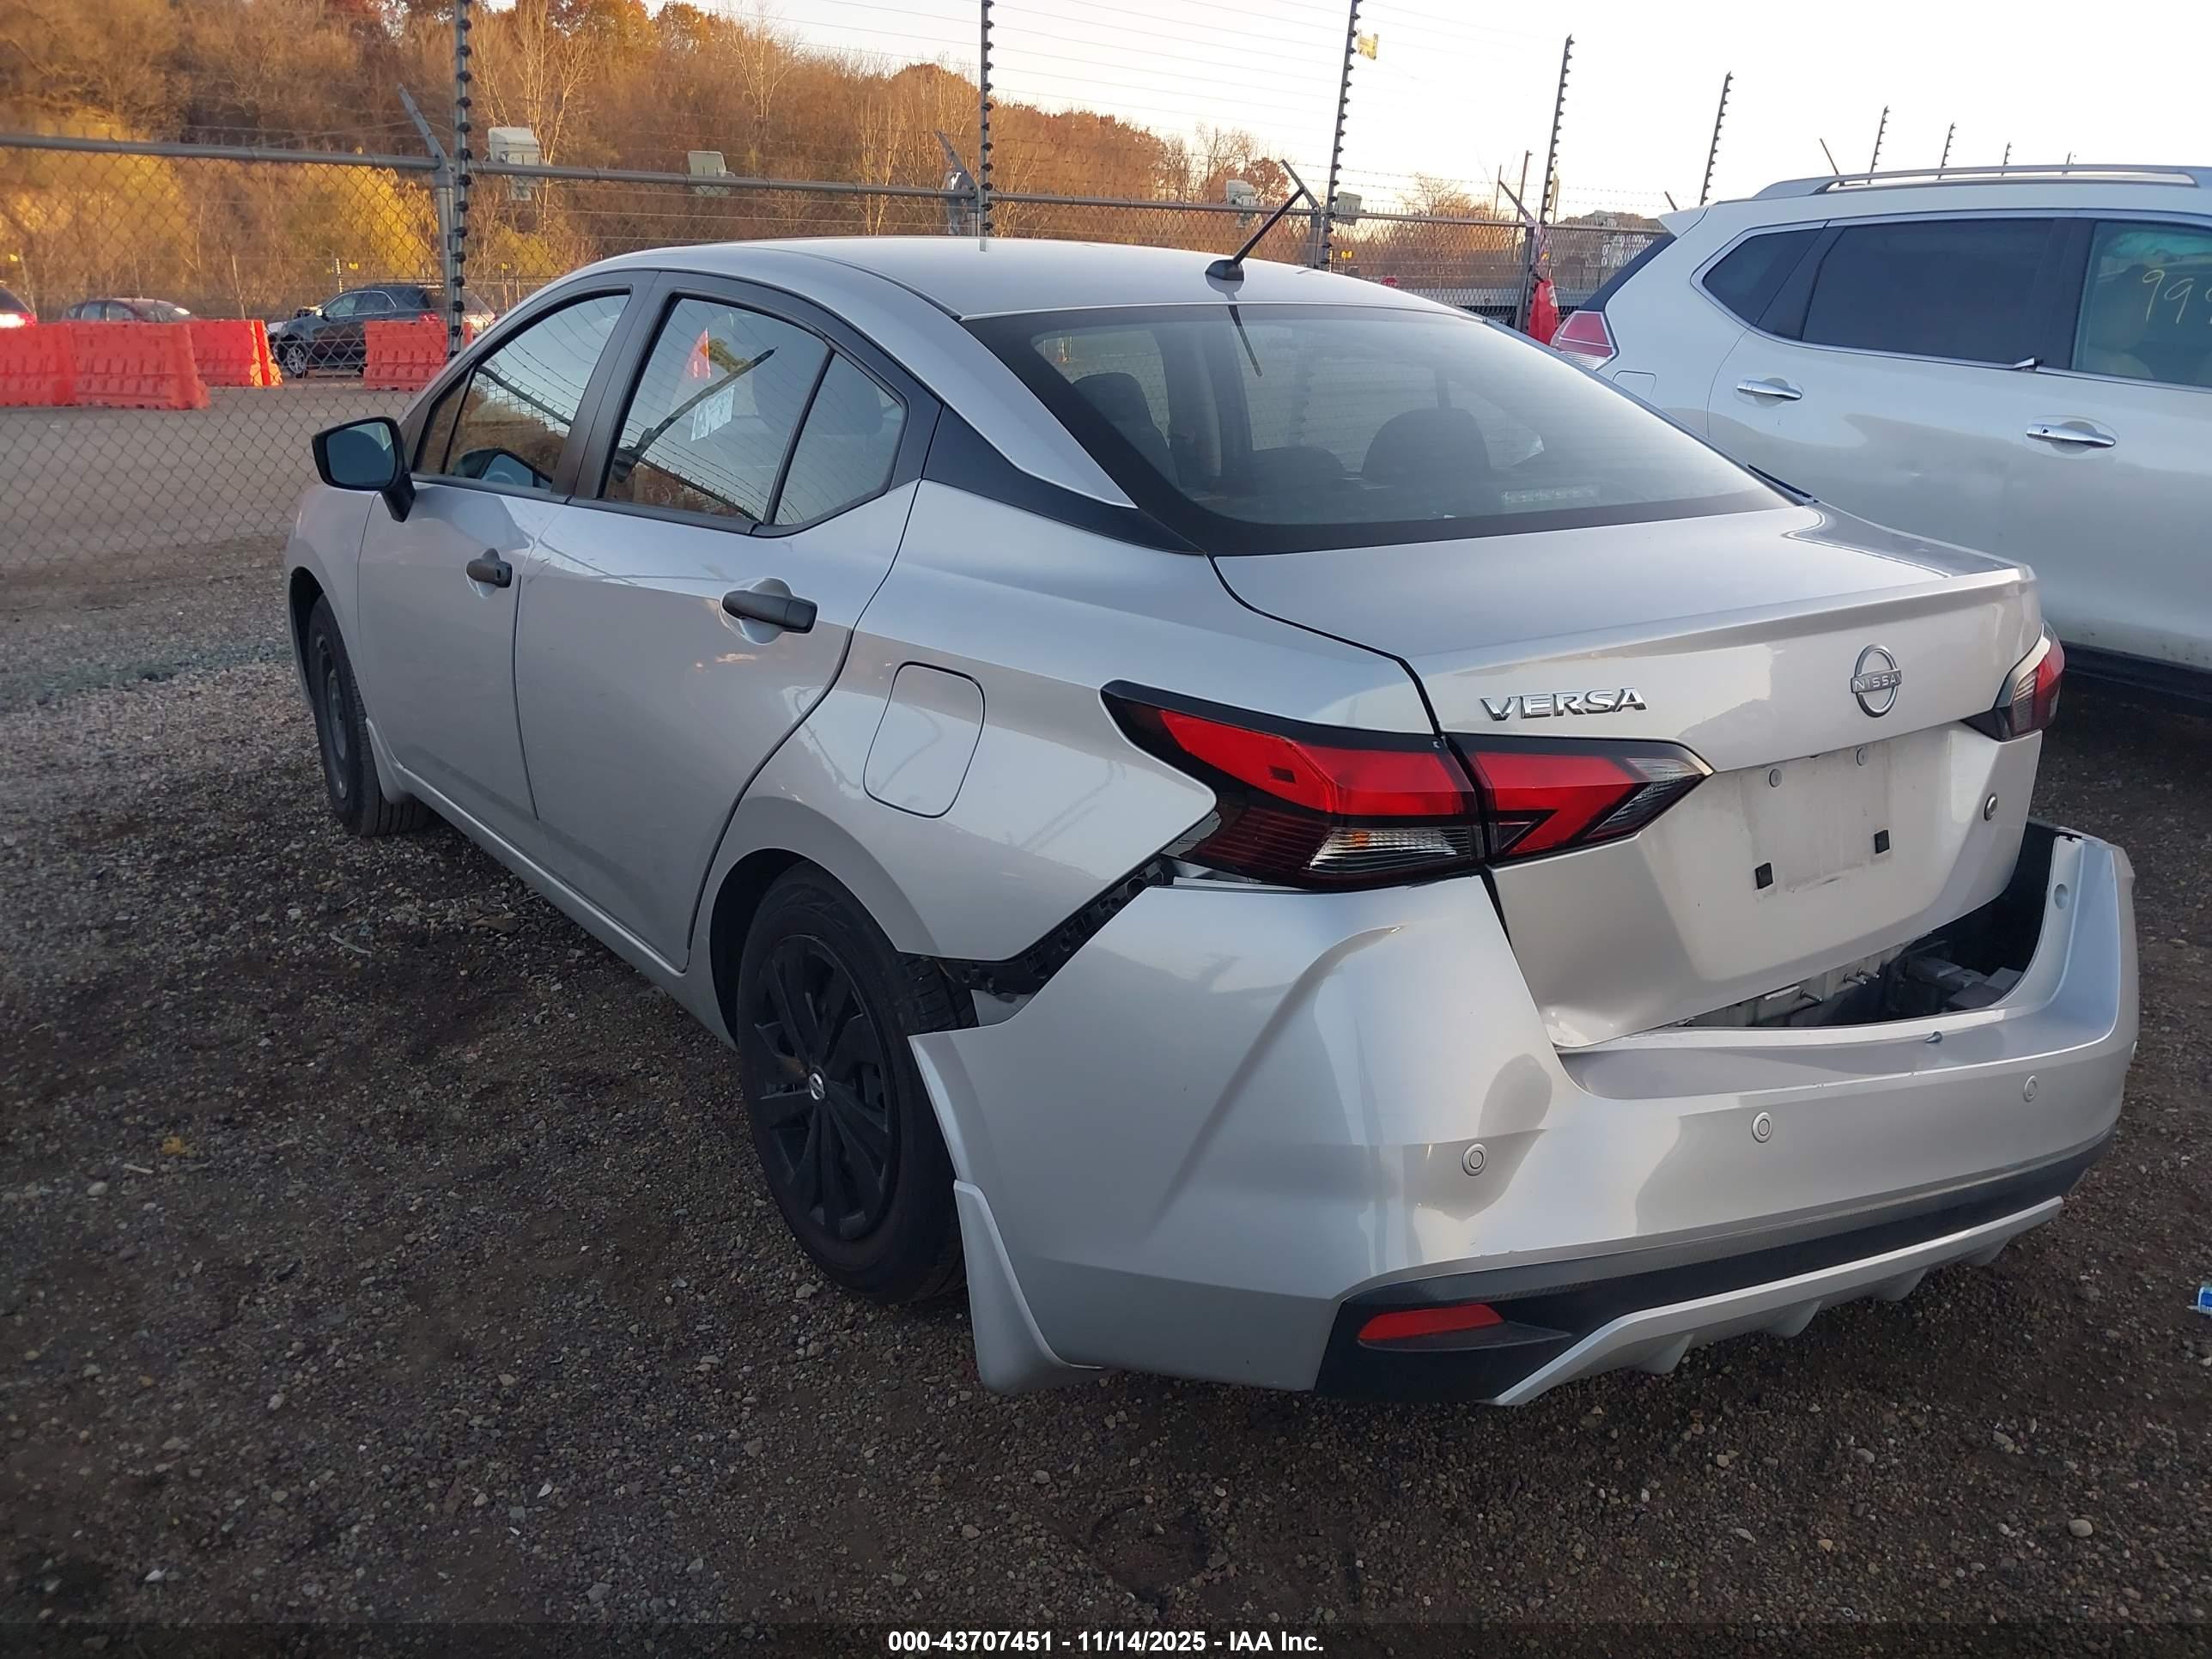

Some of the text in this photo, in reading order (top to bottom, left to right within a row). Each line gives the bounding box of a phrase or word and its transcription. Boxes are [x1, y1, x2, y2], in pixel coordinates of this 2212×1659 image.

[2142, 269, 2212, 325] 99
[1854, 672, 1902, 690] NISSAN
[1480, 687, 1648, 722] VERSA
